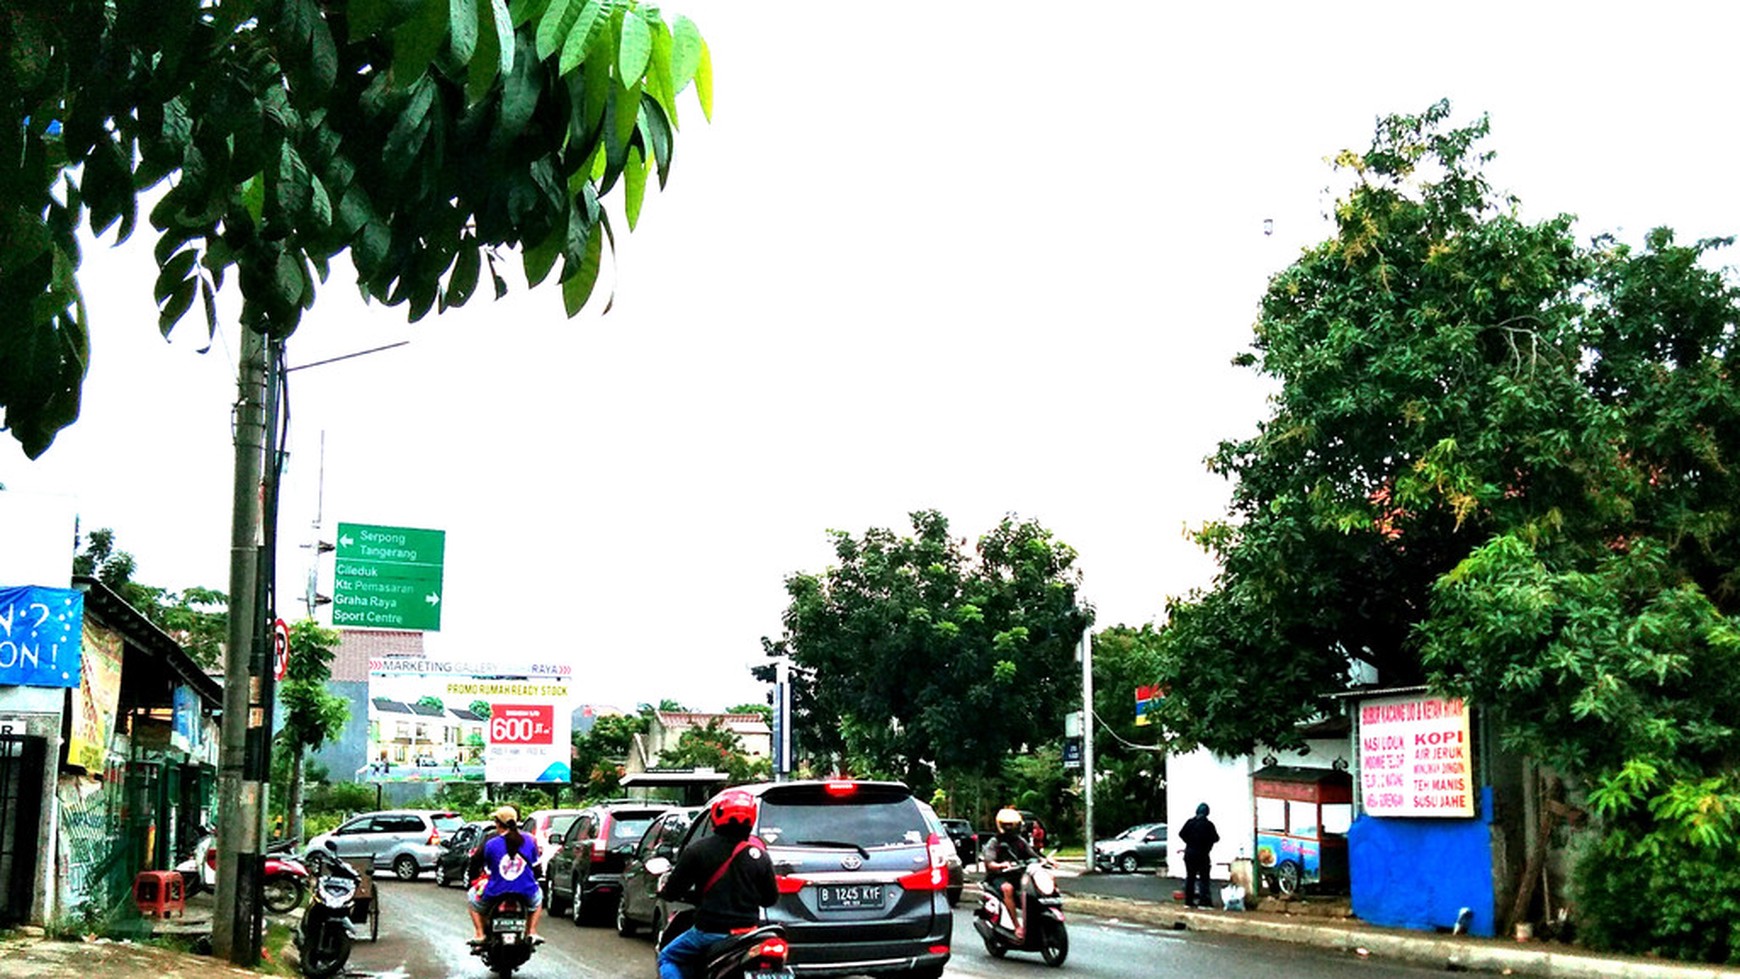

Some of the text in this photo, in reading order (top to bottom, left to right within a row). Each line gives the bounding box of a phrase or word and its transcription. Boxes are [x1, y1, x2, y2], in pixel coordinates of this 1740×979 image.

[360, 530, 406, 545] Serpong
[360, 545, 417, 561] Tangerang
[337, 564, 378, 577] Cileduk
[355, 581, 414, 594] Pemasaran
[334, 594, 397, 609] Graha Raya
[334, 610, 403, 624] Sport Centre
[382, 660, 452, 672] MARKETING
[454, 662, 497, 673] GALLERY
[531, 664, 558, 674] RAYA
[447, 683, 568, 696] PROMO RUMAH READY STOCK
[492, 718, 533, 741] 600
[1414, 730, 1463, 745] KOPI
[1415, 747, 1464, 760] AIR JERUK
[1414, 778, 1465, 791] TEH MANIS
[1414, 795, 1466, 808] SUSU JAHE
[822, 888, 829, 901] B
[835, 888, 859, 900] 1245
